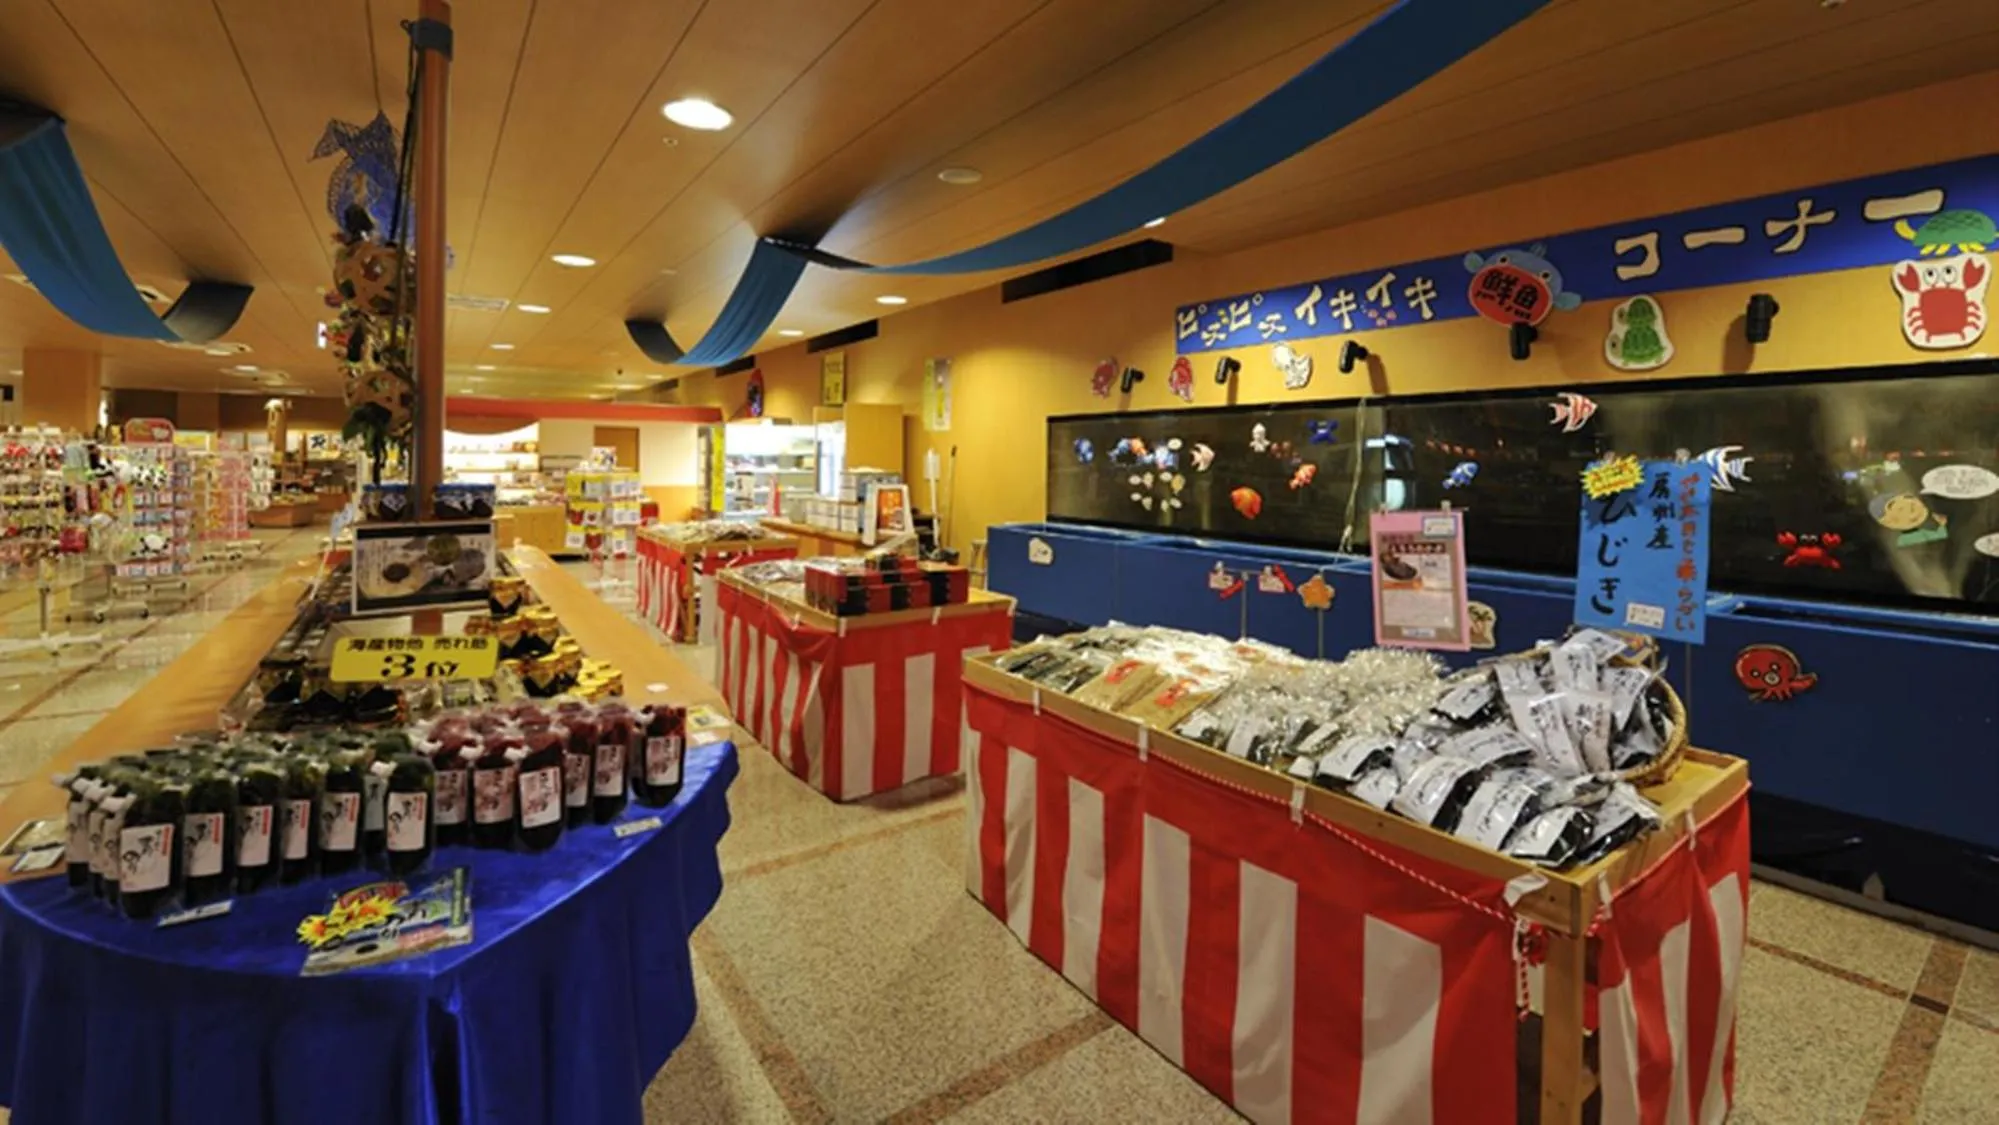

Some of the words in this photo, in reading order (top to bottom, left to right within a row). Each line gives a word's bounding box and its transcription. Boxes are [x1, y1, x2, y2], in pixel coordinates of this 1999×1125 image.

[1614, 189, 1945, 281] コーナー
[1590, 491, 1637, 615] ひじき
[381, 653, 459, 678] 3位
